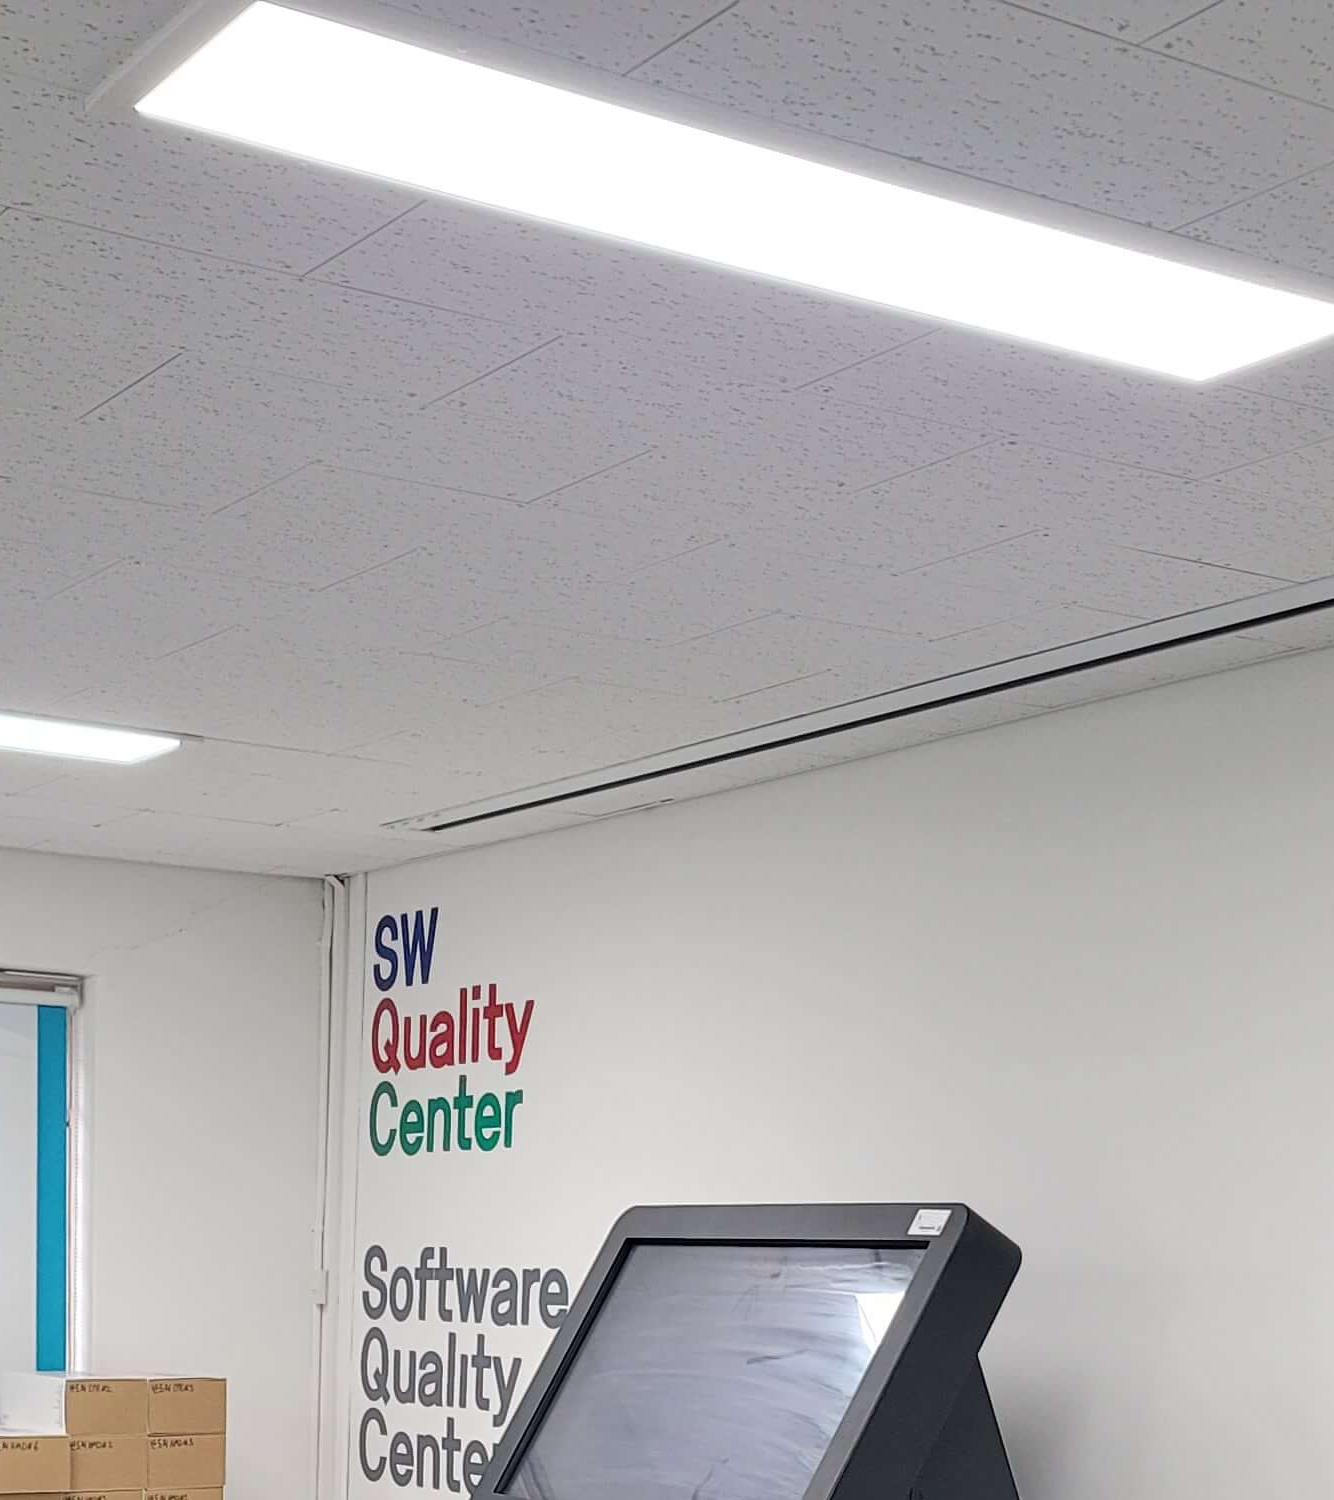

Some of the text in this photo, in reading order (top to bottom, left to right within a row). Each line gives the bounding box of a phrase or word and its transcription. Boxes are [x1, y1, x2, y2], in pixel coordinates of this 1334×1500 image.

[373, 907, 438, 991] SW
[371, 983, 535, 1075] Quality
[369, 1075, 523, 1156] Center
[362, 1245, 568, 1329] Software
[361, 1326, 522, 1427] Quality
[359, 1407, 500, 1494] Cente
